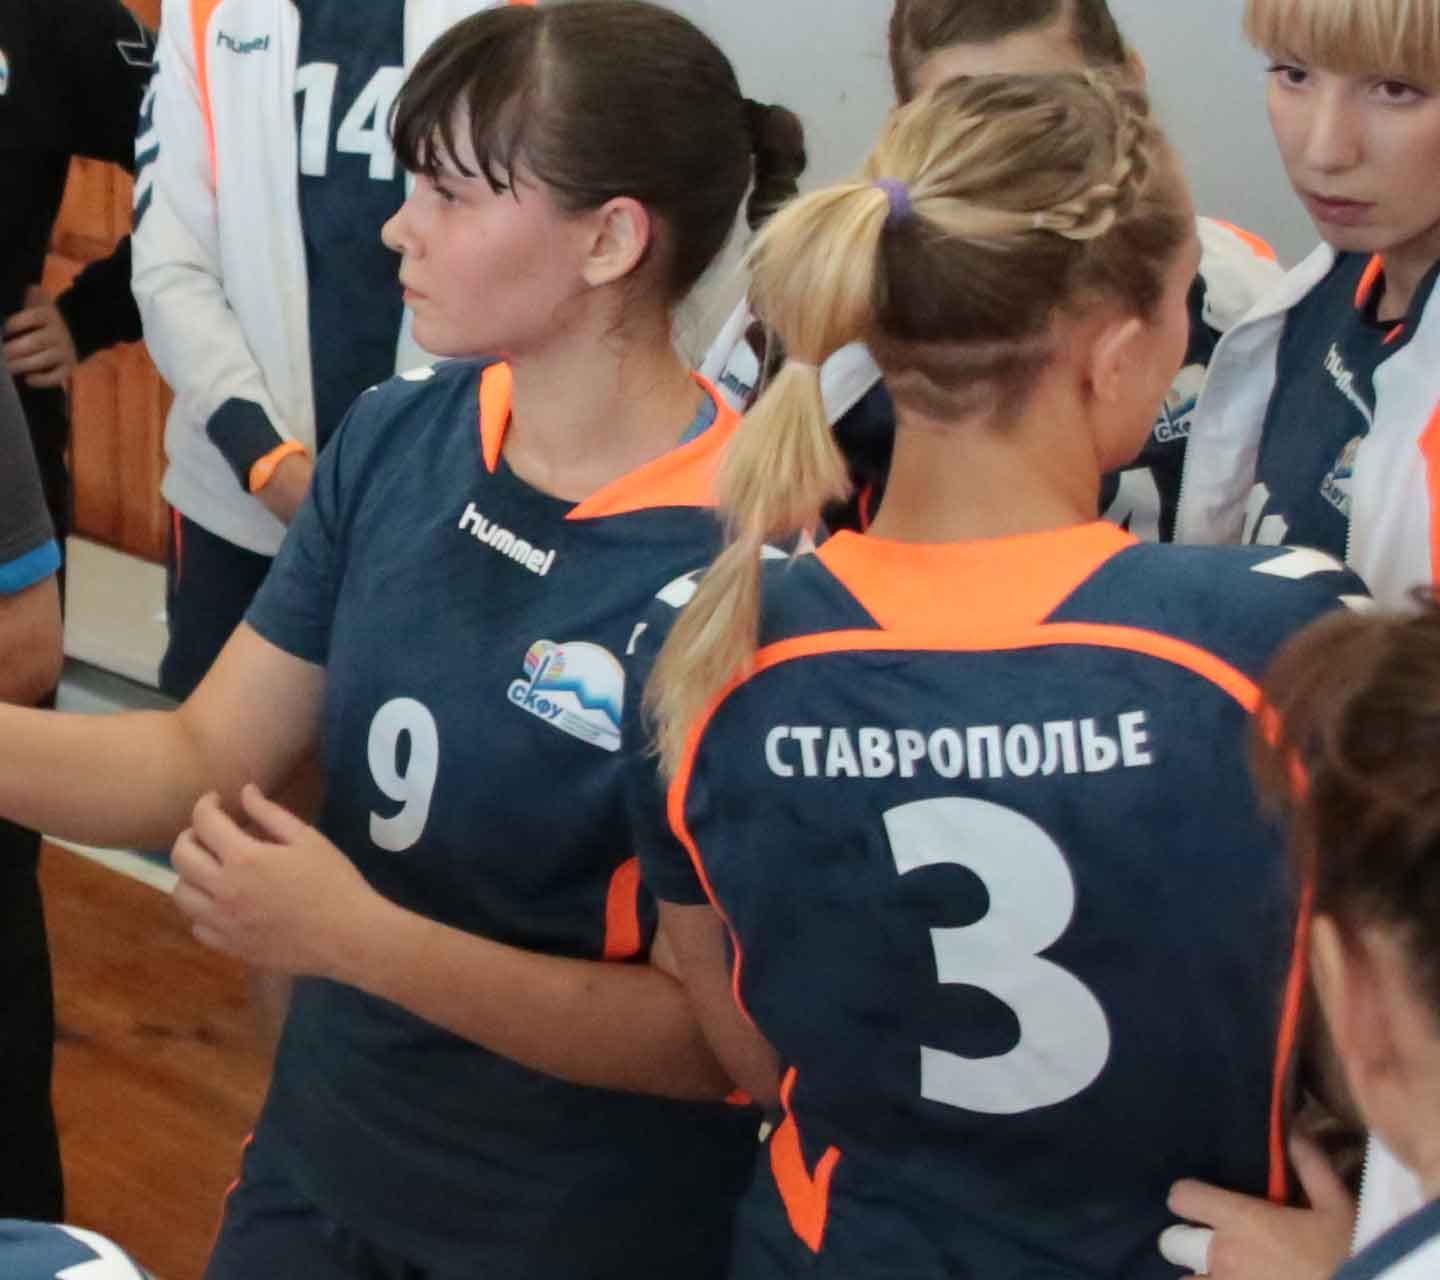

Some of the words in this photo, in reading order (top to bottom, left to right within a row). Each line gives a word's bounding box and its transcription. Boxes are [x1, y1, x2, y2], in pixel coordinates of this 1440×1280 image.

[294, 61, 406, 181] 14
[458, 501, 557, 577] hummel
[511, 684, 563, 720] СКФУ
[764, 710, 1153, 780] СТАВРОПОЛЬЕ
[367, 697, 439, 852] 9
[882, 796, 1111, 1115] 3
